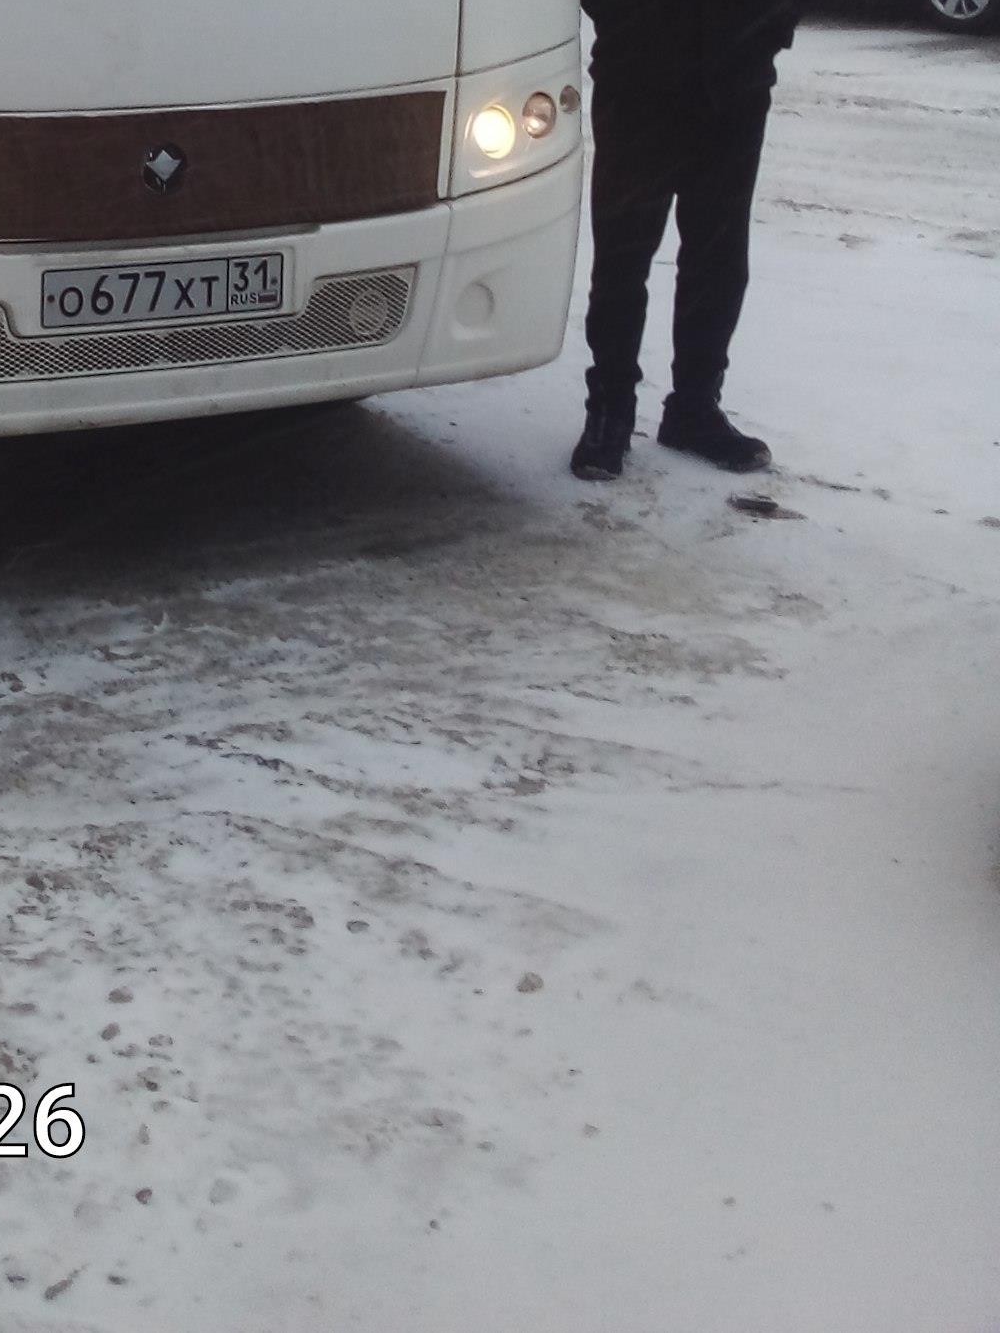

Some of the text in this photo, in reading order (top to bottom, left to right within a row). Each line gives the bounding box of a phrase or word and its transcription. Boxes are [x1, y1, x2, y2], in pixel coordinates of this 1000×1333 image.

[58, 259, 270, 317] О677ХТ 31
[230, 292, 258, 306] RUS
